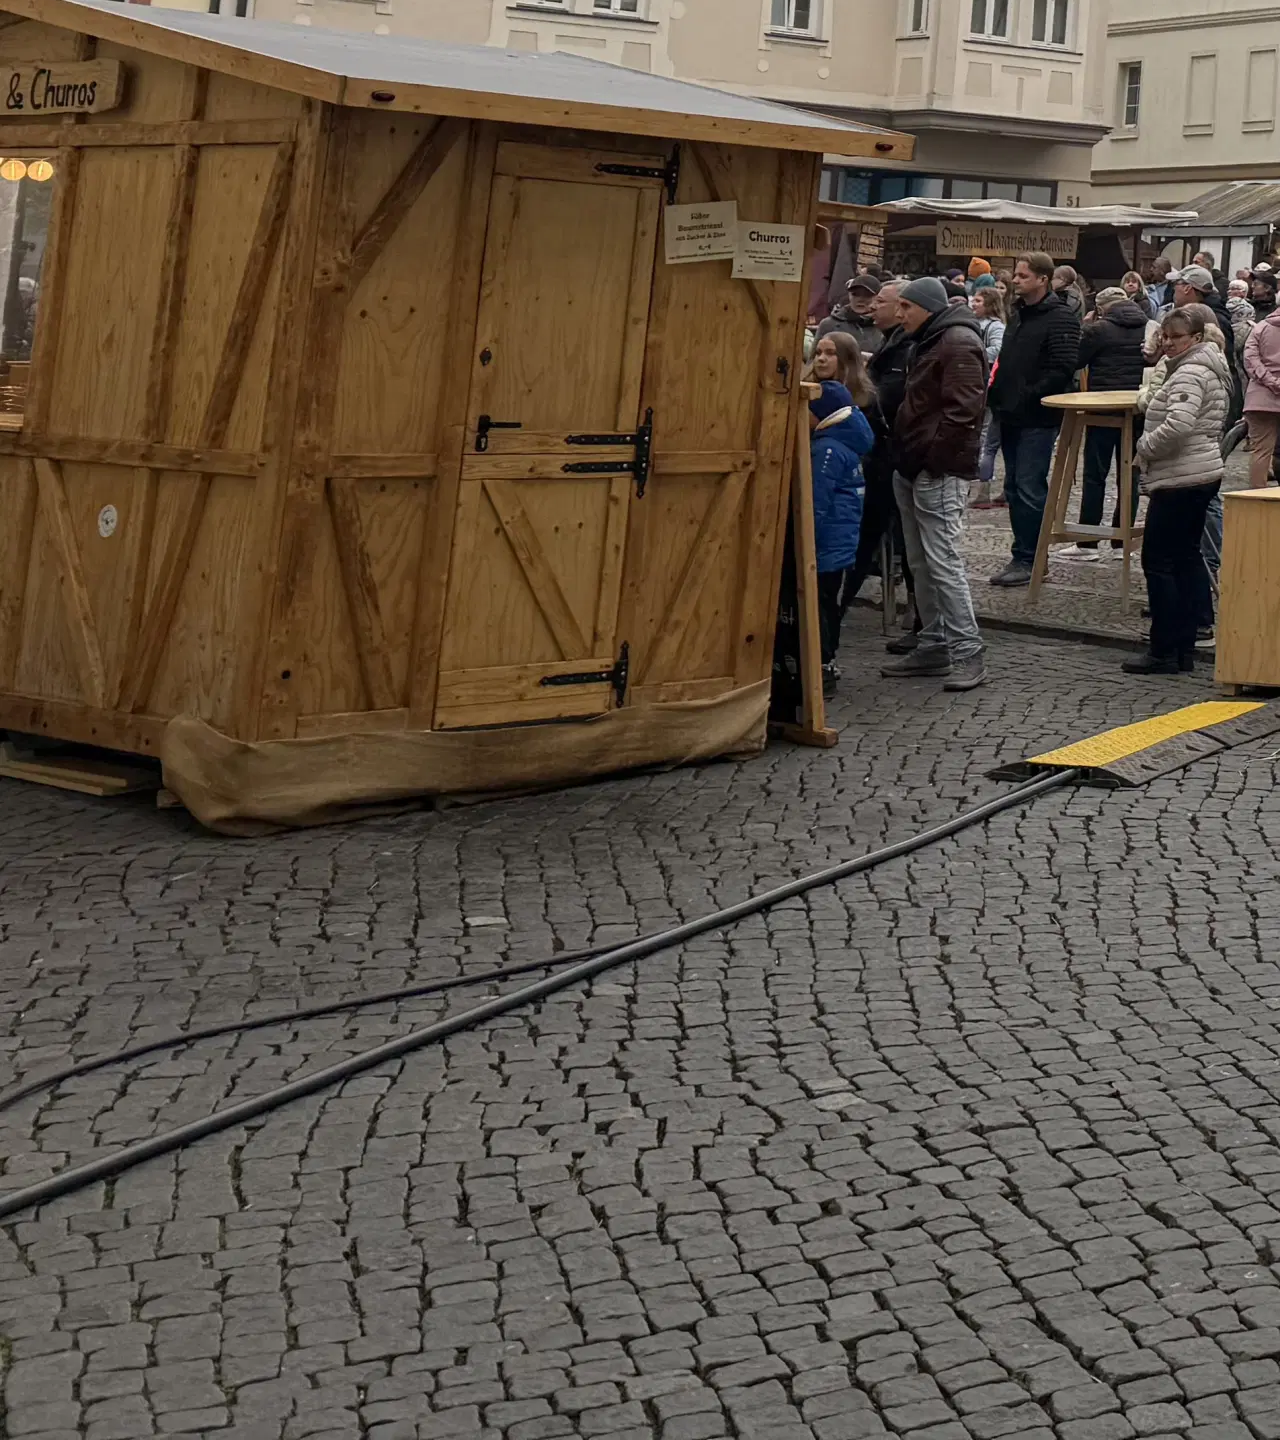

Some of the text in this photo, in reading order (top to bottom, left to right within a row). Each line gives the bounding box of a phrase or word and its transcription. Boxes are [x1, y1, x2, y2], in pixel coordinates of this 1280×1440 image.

[6, 68, 98, 110] & Churros
[1066, 195, 1081, 208] 51
[748, 230, 792, 244] Churros
[941, 226, 982, 252] Original
